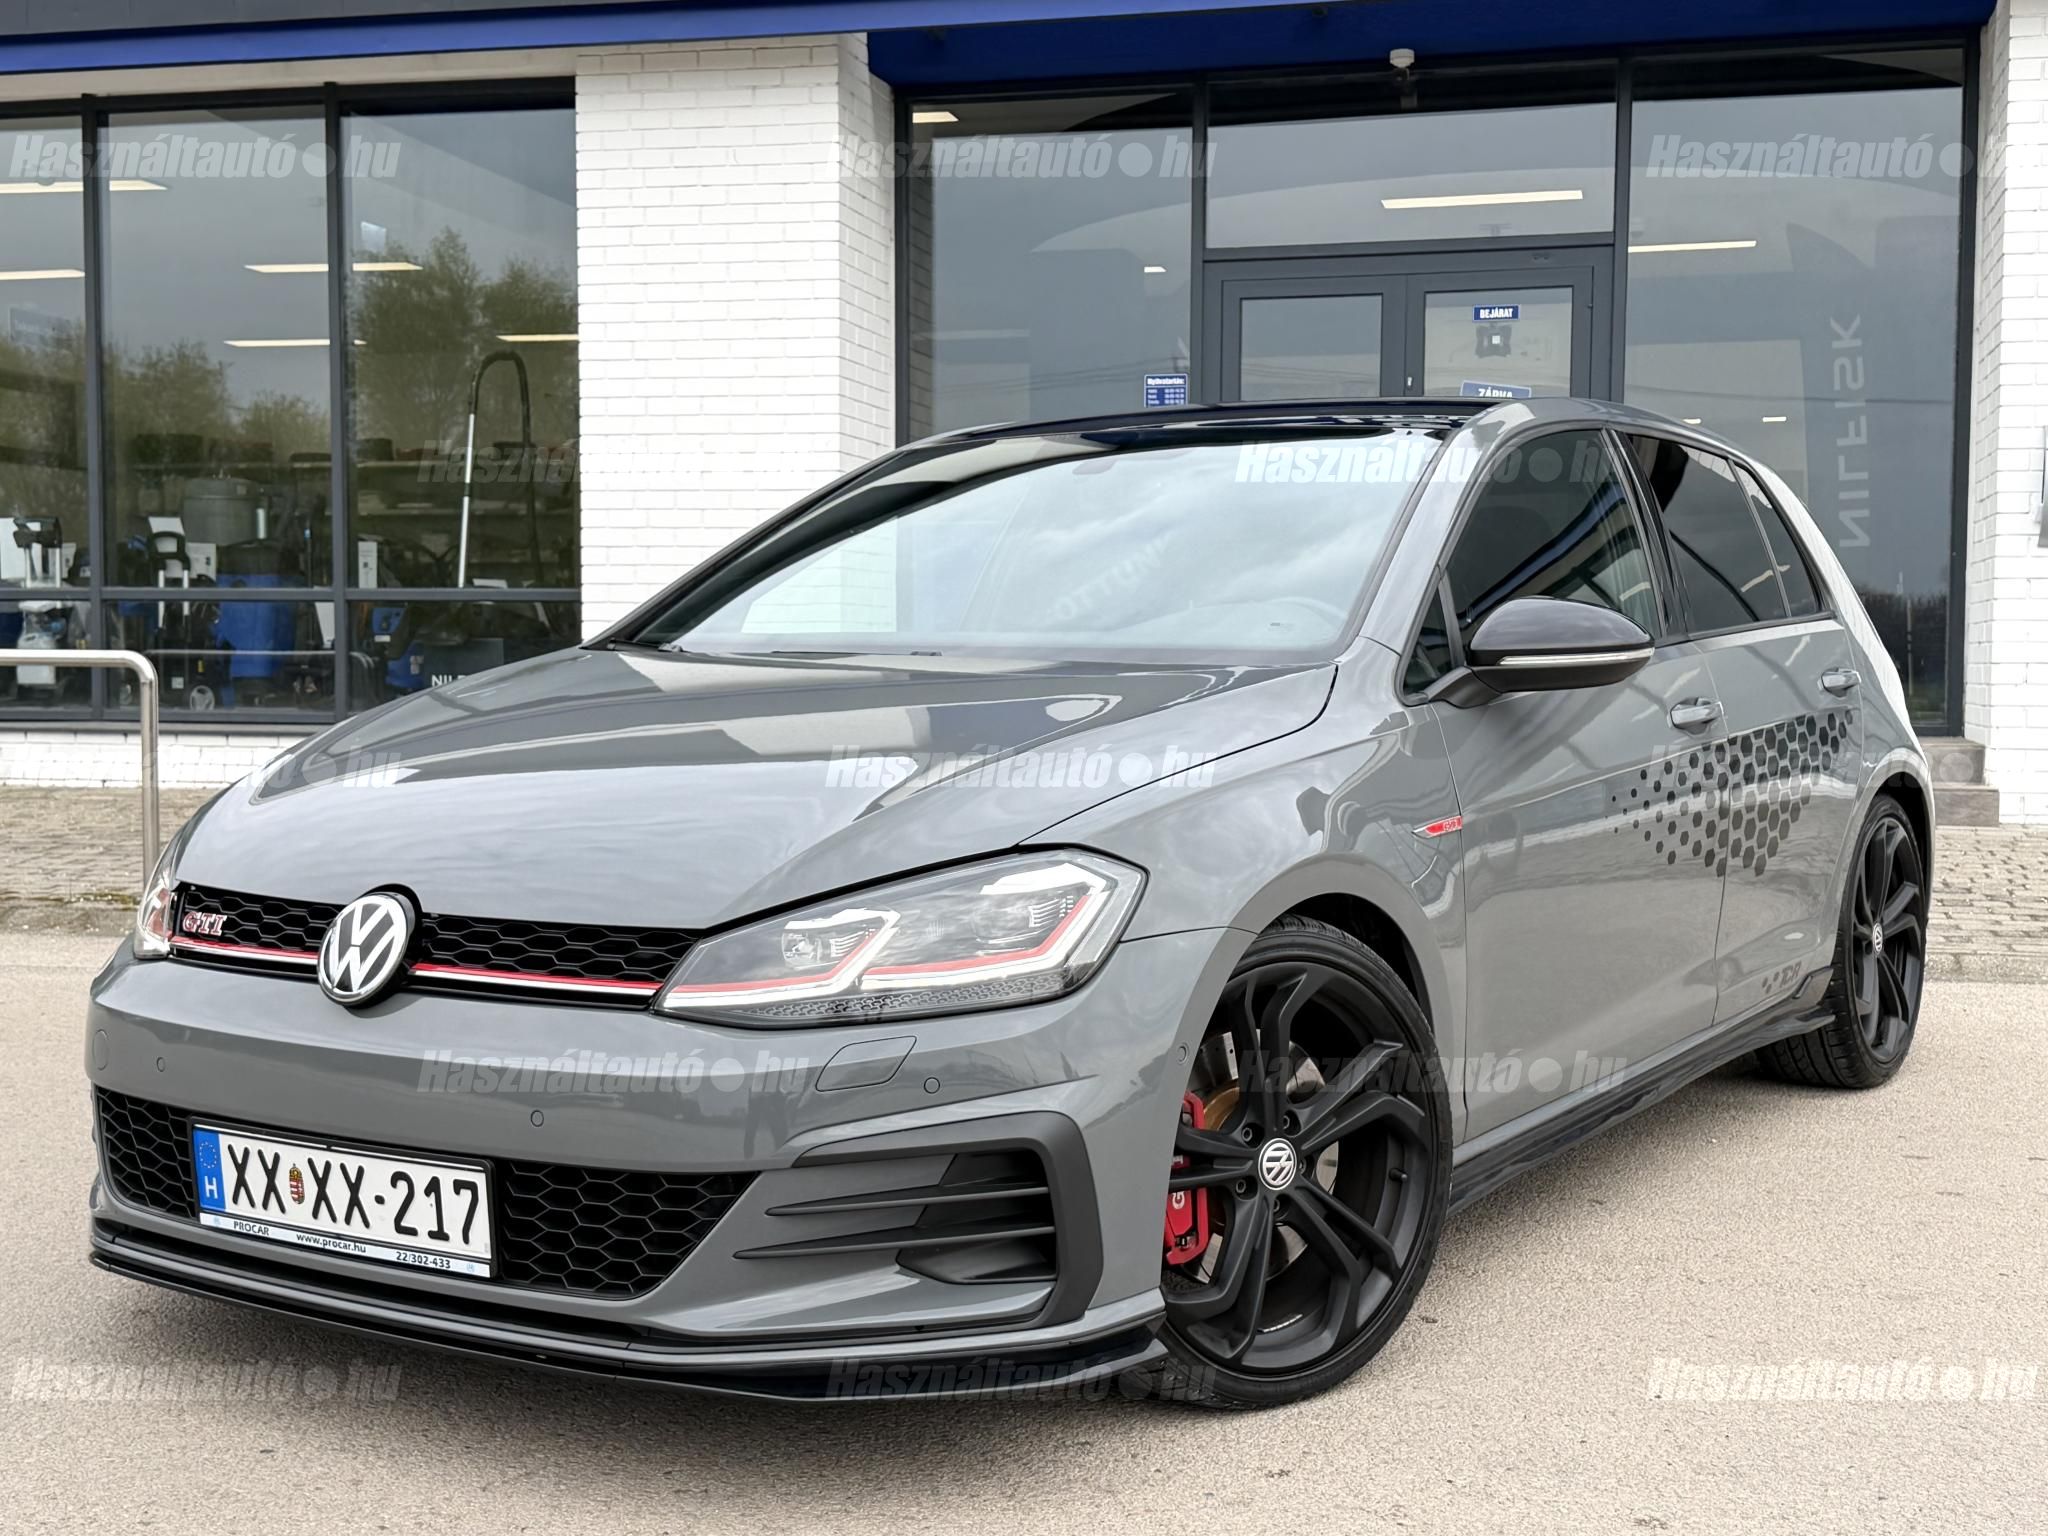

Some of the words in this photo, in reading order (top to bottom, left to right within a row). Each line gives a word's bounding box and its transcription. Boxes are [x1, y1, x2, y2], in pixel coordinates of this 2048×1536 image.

[1480, 307, 1513, 319] BEJÁRAT
[183, 911, 228, 936] GTI
[204, 1176, 218, 1199] H
[227, 1143, 286, 1214] XX
[307, 1157, 479, 1245] XX-217
[233, 1220, 270, 1236] PROCAR
[296, 1233, 367, 1254] www.procar.hu
[395, 1251, 451, 1269] 22/302-433
